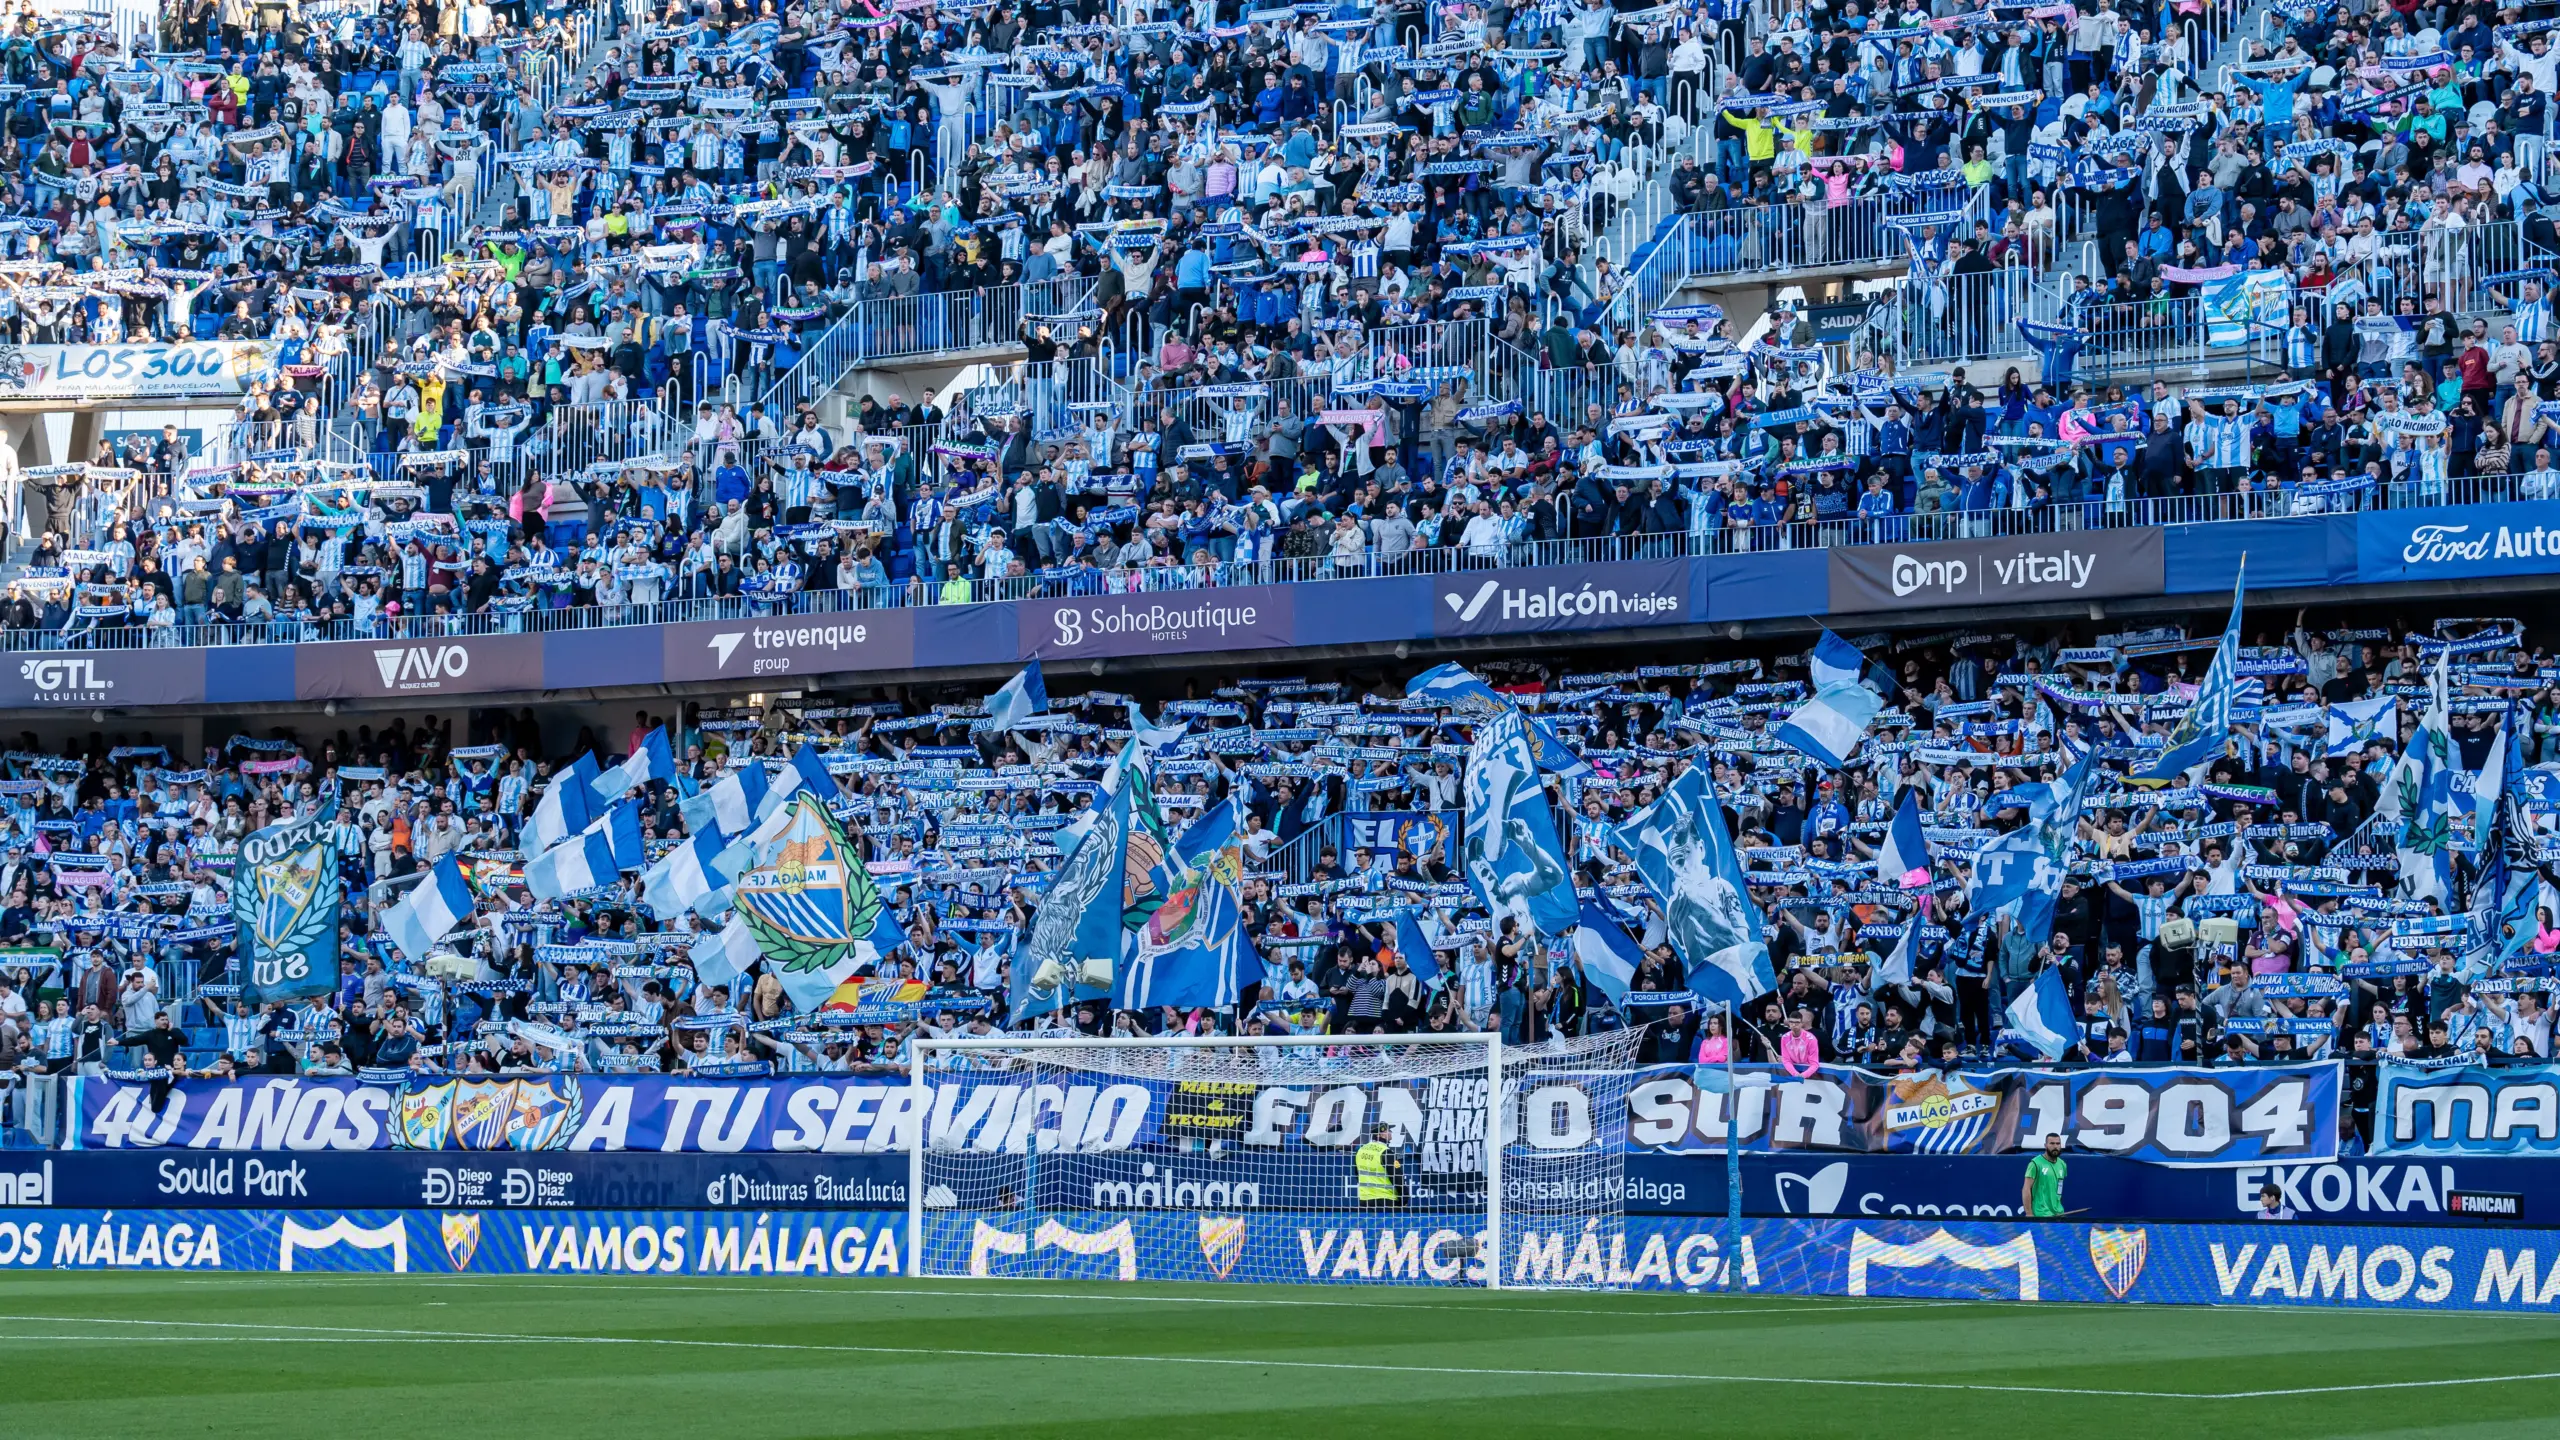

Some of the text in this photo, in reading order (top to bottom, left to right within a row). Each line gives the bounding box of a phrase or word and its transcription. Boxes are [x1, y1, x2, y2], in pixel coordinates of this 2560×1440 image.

[1444, 40, 1475, 51] HICIMOS!
[450, 64, 492, 73] MALAGA
[1984, 93, 2029, 104] INVENCIBLES
[2166, 103, 2200, 115] HICIMOS!
[2137, 118, 2181, 130] MALAGA
[234, 128, 271, 141] INVENCIBLES
[1345, 126, 1386, 135] INVENCIBLES
[2092, 139, 2136, 153] MALAGA
[1432, 162, 1478, 173] MALAGA
[79, 181, 91, 193] 95
[211, 182, 244, 196] MALAGA
[1371, 191, 1407, 201] MALAGA
[489, 231, 519, 240] MALAGA
[1115, 236, 1152, 247] MALAGA
[1488, 237, 1527, 248] MALAGA
[2174, 271, 2230, 281] MALAGUISTA
[1454, 287, 1499, 299] MALAGA
[1820, 316, 1862, 330] SALIDA
[56, 347, 223, 380] LOS 300
[84, 384, 143, 392] MALAGUISTA
[163, 383, 221, 391] BARCELONA
[1208, 385, 1252, 394] MALAGACF
[1468, 403, 1509, 419] Malaga
[1323, 412, 1371, 424] MALAGUISTA
[2387, 419, 2440, 434] ¡LO HICIMOS!
[934, 441, 989, 458] MALAGACF
[408, 452, 455, 464] MALAGA
[1788, 457, 1844, 471] MALAGACF
[1942, 455, 1985, 467] MALAGA
[27, 465, 76, 477] MALAGA
[2308, 477, 2369, 494] MALAGA
[2403, 525, 2489, 563] Ford
[63, 551, 108, 562] MALAGA
[1994, 549, 2096, 588] vitaly
[1503, 584, 1677, 620] Halcón viajes
[1090, 604, 1255, 636] SohoBoutique
[753, 622, 866, 650] trevenque
[1151, 632, 1188, 641] HOTELS
[753, 657, 789, 673] group
[34, 660, 104, 688] GTL
[34, 692, 106, 701] ALQUILER
[805, 707, 870, 719] FONDO SUR
[1182, 703, 1232, 713] MALAGA
[701, 719, 760, 731] FONDO SUR
[874, 715, 941, 731] FONDO SUR
[1211, 739, 1252, 751] MALAGA
[1001, 763, 1065, 775] FONDO SUR
[1352, 819, 1398, 848] EL
[2201, 823, 2227, 835] SUR
[55, 855, 77, 863] PORQUE
[2247, 867, 2342, 879] FONDO SUR
[1336, 898, 1374, 908] FONDO
[979, 921, 1014, 931] HINCHAS
[1860, 927, 1947, 938] FONDO SUR
[2394, 936, 2436, 947] FONDO
[2506, 956, 2541, 969] MALAKA
[616, 966, 695, 978] FONDO SUR
[1635, 994, 1657, 1002] PORQUE
[1669, 991, 1692, 1000] QUIERO
[907, 1001, 936, 1009] MALAKA
[588, 1026, 665, 1037] FONDO SUR
[2228, 1021, 2331, 1032] MALAKA HINCHAS
[785, 1033, 819, 1043] FONDO
[107, 1070, 168, 1080] FONDO SUR
[698, 1063, 763, 1076] MALAKA HINCHAS
[94, 1078, 388, 1151] 40 AÑOS
[1629, 1077, 1846, 1146] SUR
[1897, 1104, 1957, 1122] MALAGA
[2029, 1082, 2308, 1152] 1904
[576, 1084, 1150, 1153] A TU SERVICIO
[1425, 1109, 1487, 1141] PARA
[159, 1159, 306, 1197] Sould Park
[458, 1169, 493, 1183] Diego
[538, 1169, 573, 1183] Diego
[458, 1182, 484, 1198] Díaz
[538, 1182, 565, 1198] Díaz
[731, 1173, 906, 1205] Pinturas Andalucía
[1094, 1162, 1259, 1206] málaga
[1606, 1177, 1685, 1204] Málaga
[2451, 1193, 2516, 1214] #FANCAM
[54, 1211, 221, 1265] MÁLAGA
[524, 1213, 899, 1273] VAMOS MÁLAGA
[1515, 1217, 1761, 1287] MÁLAGA
[2210, 1243, 2455, 1302] VAMOS
